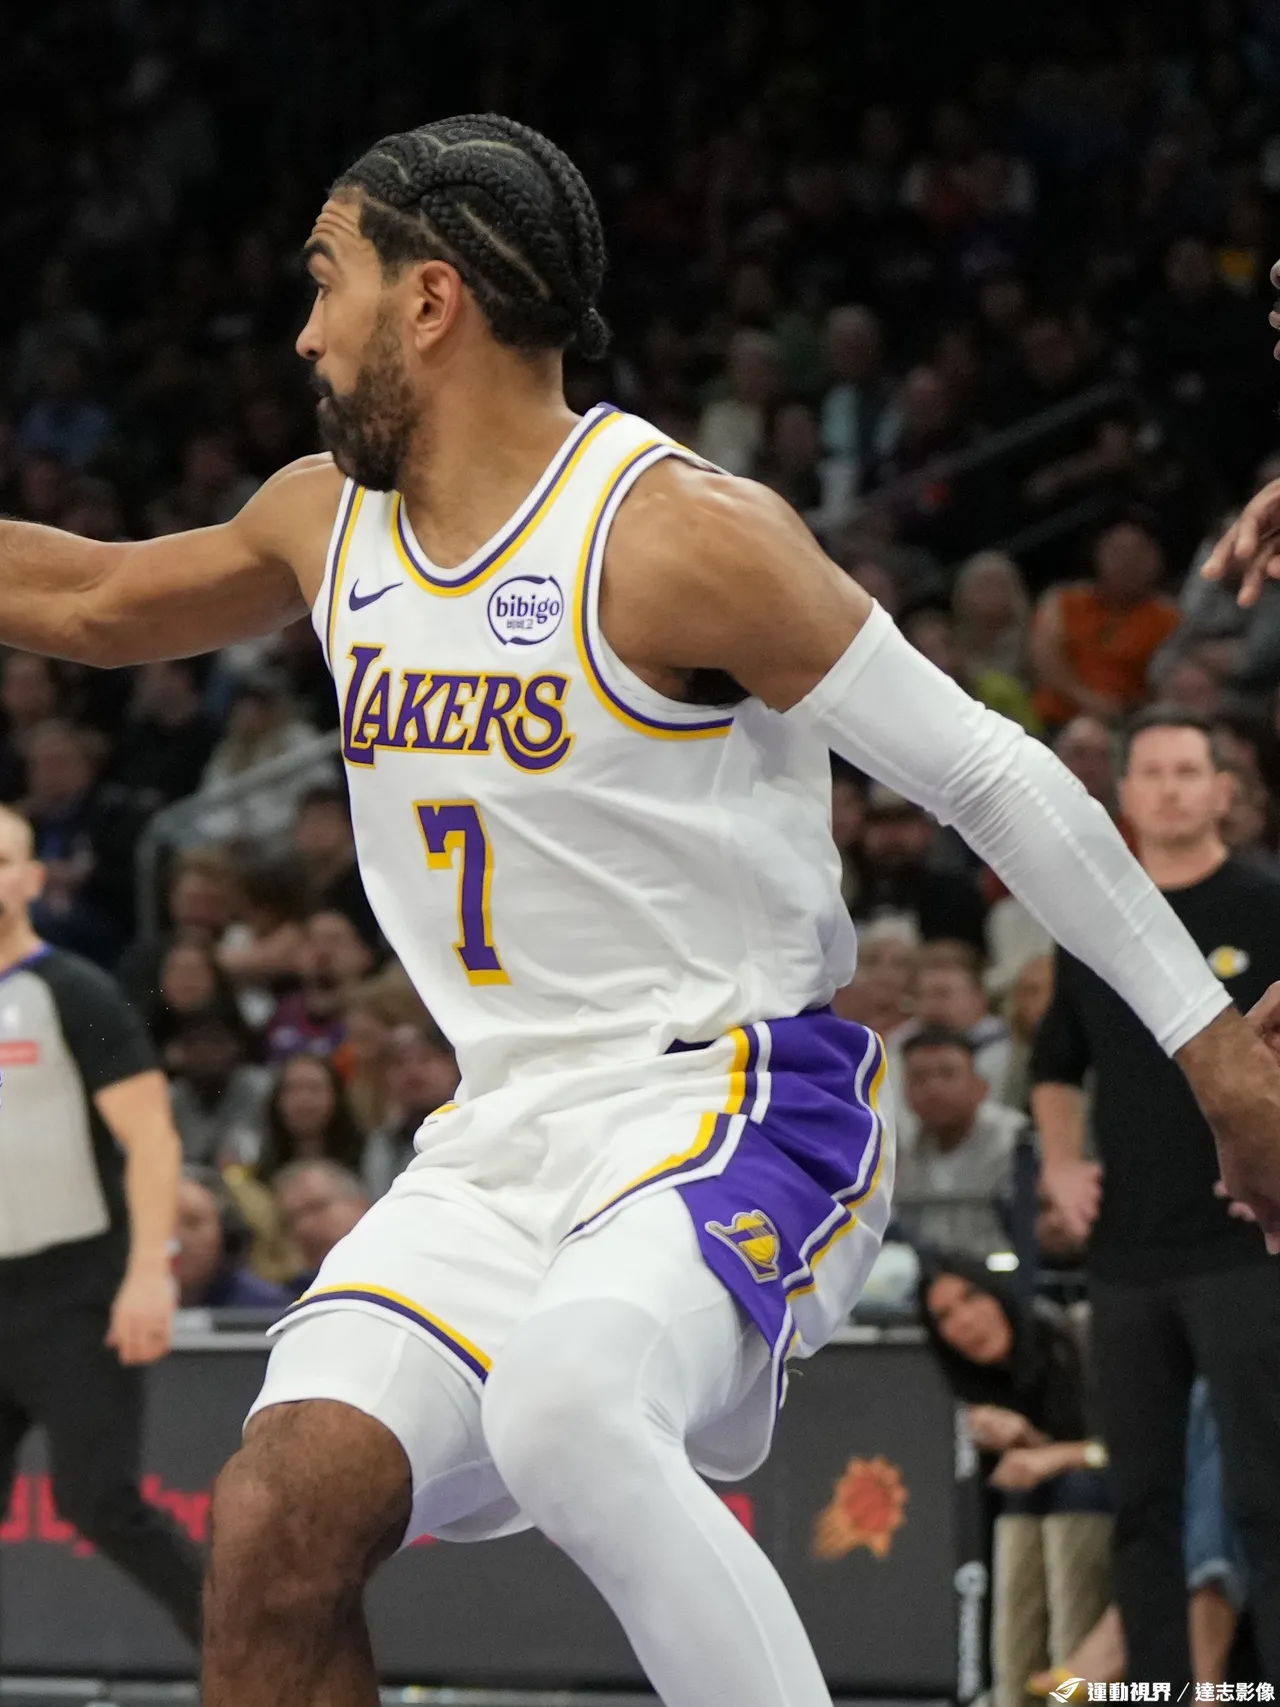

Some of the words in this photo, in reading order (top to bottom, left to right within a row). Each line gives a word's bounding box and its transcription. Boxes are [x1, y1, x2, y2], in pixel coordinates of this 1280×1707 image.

[496, 594, 560, 624] bibigo
[341, 642, 577, 774] LAKERS
[412, 798, 513, 987] 7
